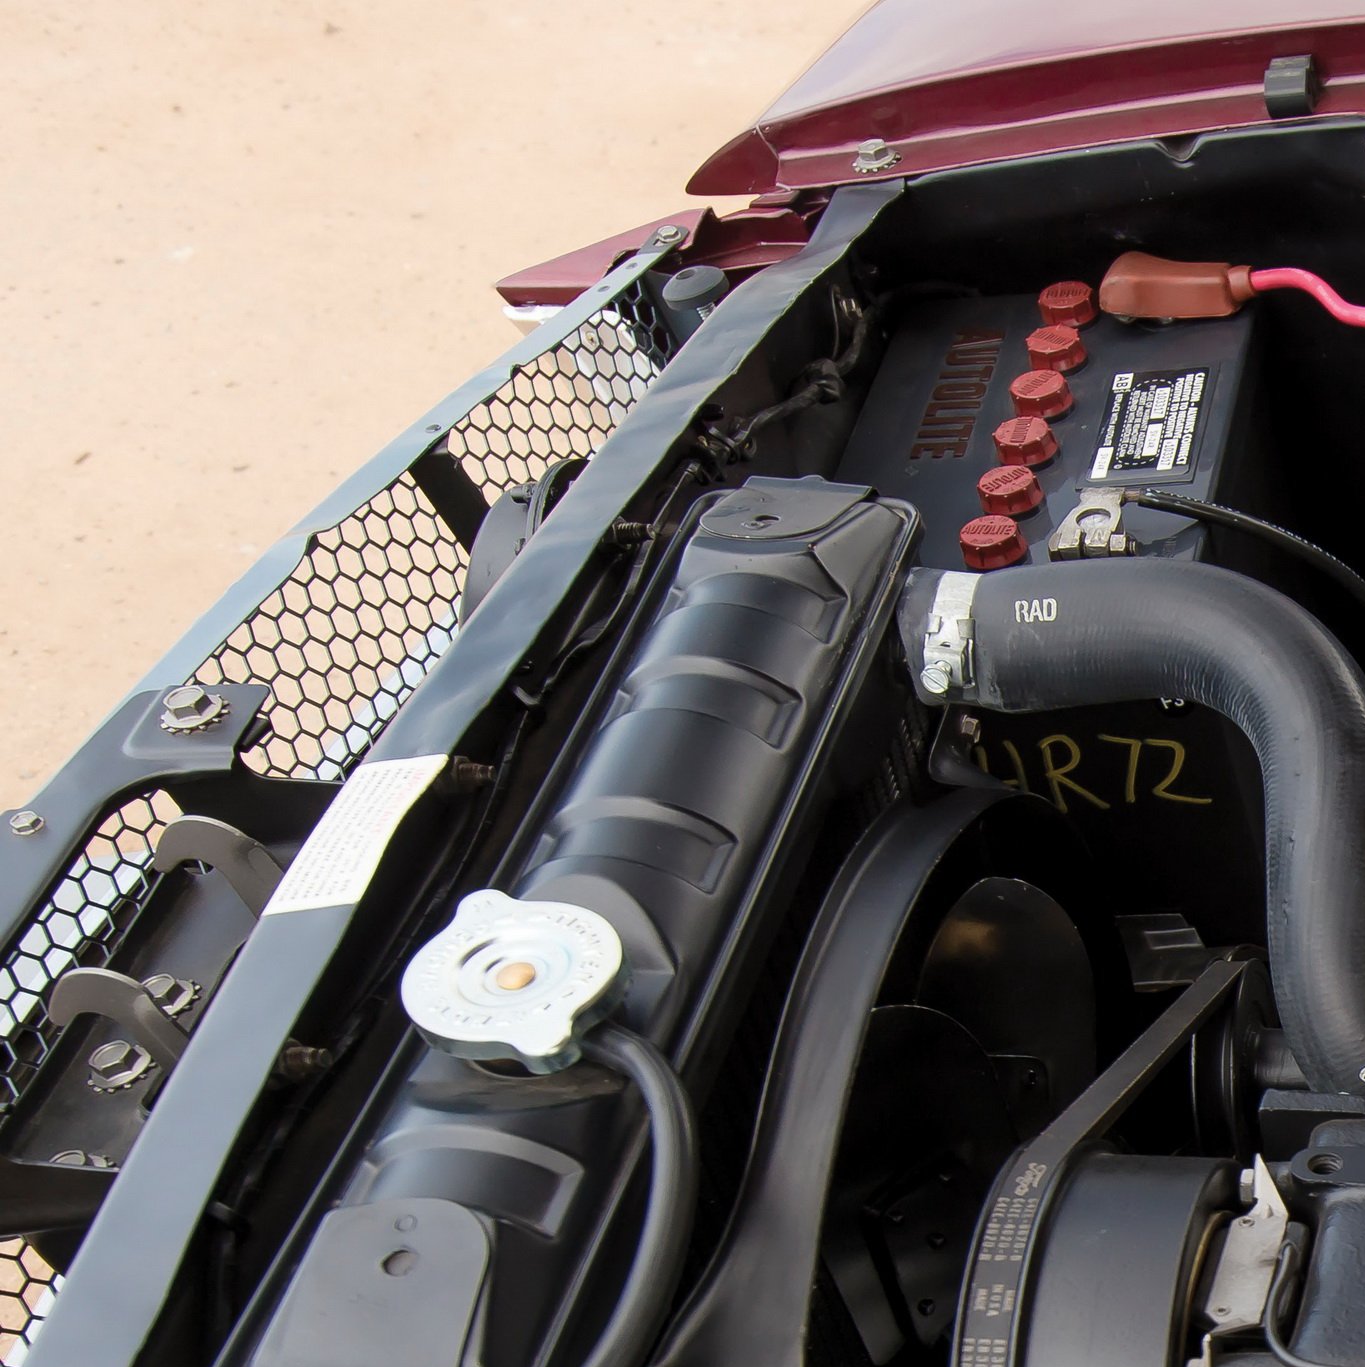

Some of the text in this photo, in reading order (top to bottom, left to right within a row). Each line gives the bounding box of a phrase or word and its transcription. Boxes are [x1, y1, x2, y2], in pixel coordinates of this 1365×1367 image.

[1117, 377, 1129, 387] AB
[909, 329, 1006, 460] AUTOLITE
[1176, 434, 1193, 464] CONNECT
[962, 523, 1014, 536] AUTOLITE
[1015, 598, 1058, 622] RAD
